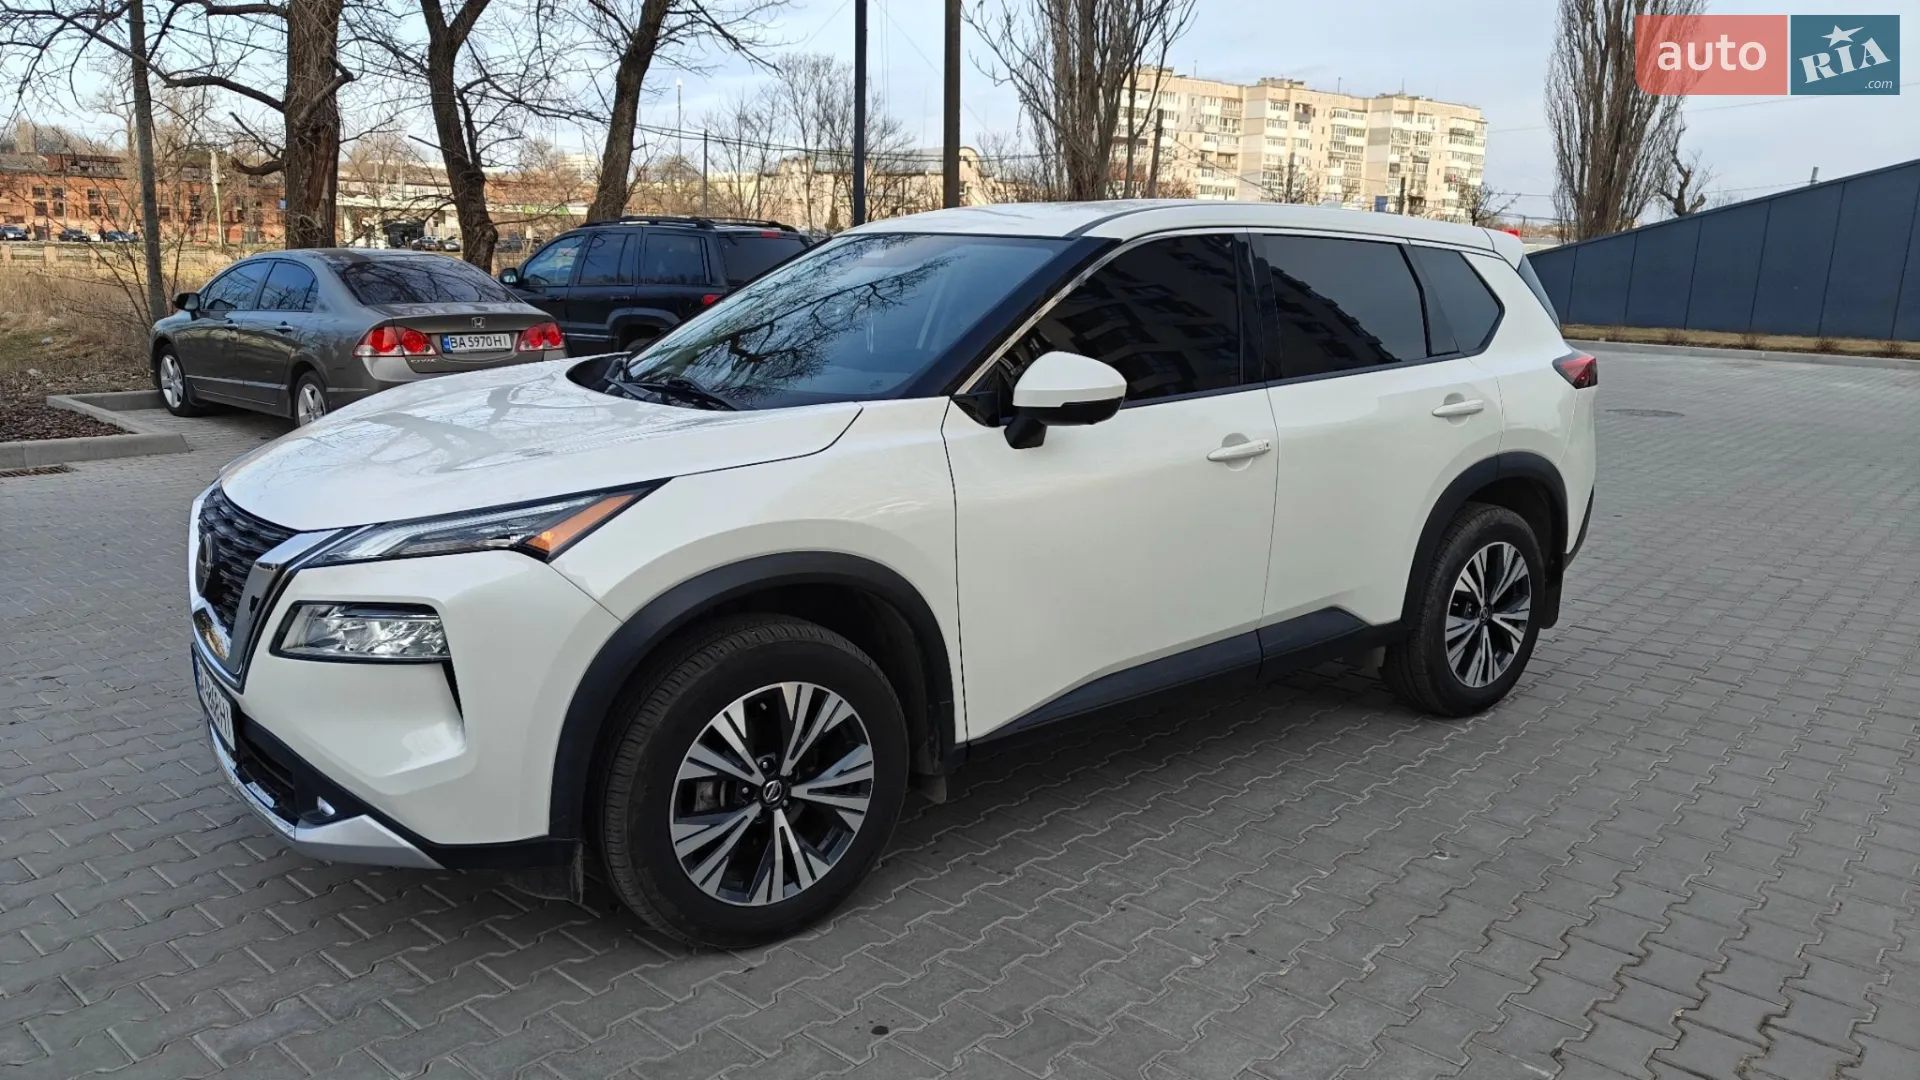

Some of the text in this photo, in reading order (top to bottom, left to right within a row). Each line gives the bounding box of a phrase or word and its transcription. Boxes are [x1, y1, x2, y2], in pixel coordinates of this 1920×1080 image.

[450, 335, 507, 348] BA 5970 HI
